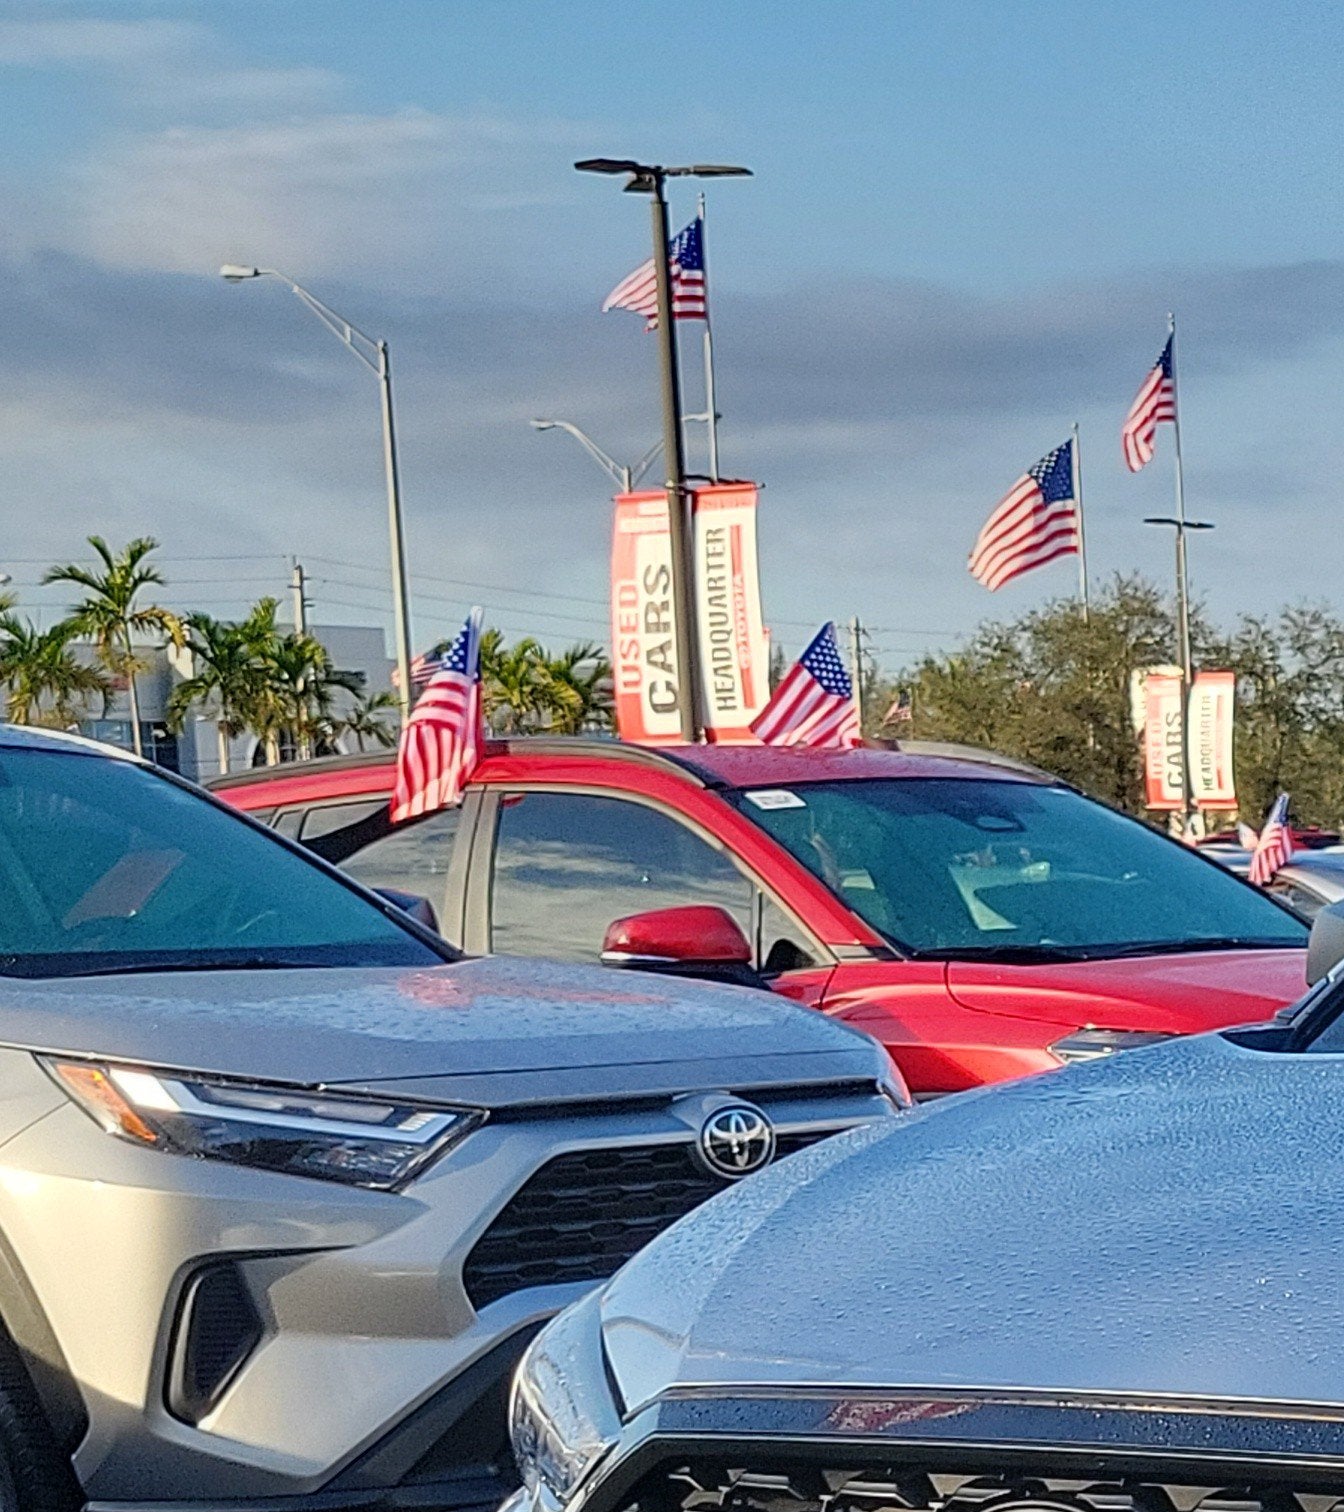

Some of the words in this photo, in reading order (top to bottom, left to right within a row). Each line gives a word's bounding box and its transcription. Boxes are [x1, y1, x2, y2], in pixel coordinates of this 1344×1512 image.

[618, 585, 642, 688] USED
[643, 564, 679, 713] CARS
[705, 527, 738, 711] HEADQUARTER
[1166, 712, 1182, 788] CARS
